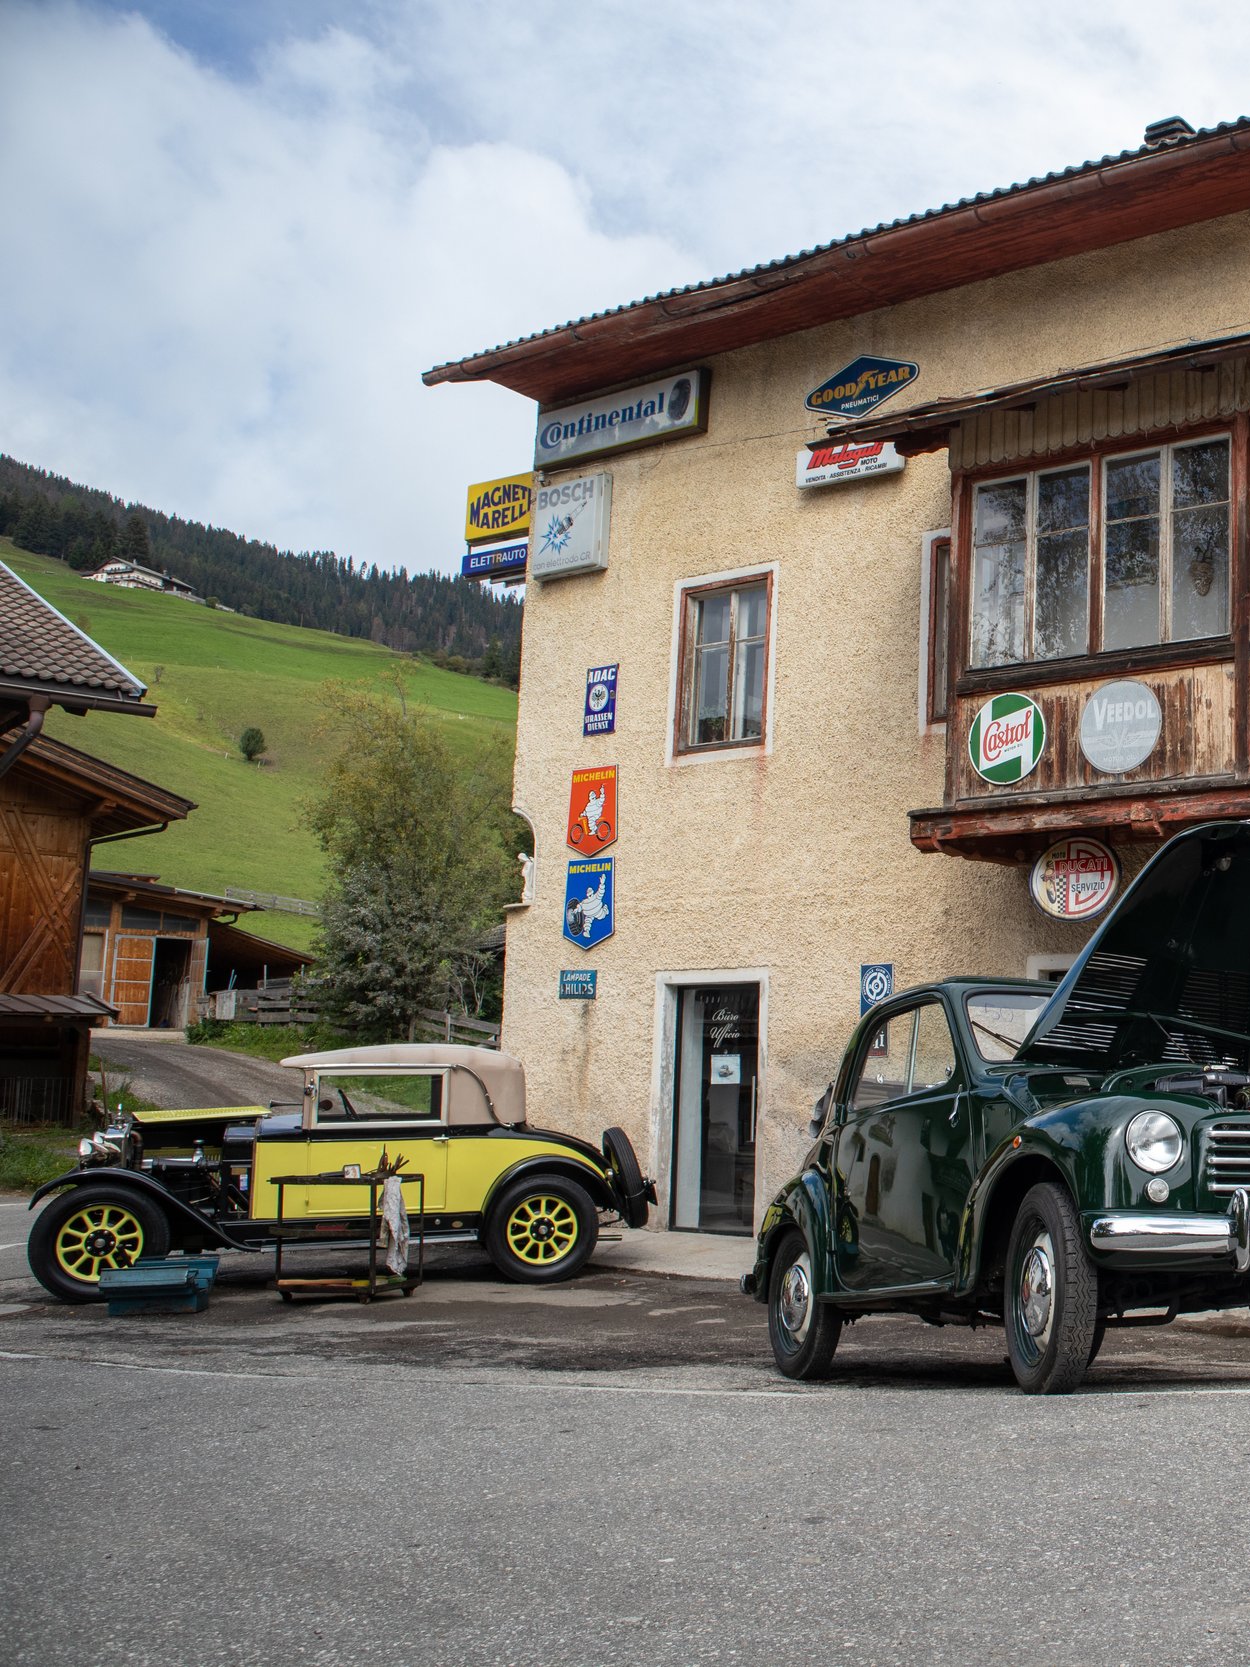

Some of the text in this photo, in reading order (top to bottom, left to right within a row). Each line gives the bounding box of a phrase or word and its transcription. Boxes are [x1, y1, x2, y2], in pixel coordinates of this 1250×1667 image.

[840, 394, 880, 410] PNEUMATICI
[539, 391, 666, 450] Continental
[860, 457, 878, 466] MOTO
[805, 462, 888, 484] VENDITA ASSISTENZA RICAMBI
[537, 479, 595, 511] BOSCH
[470, 548, 527, 569] ELETTRAUTO
[533, 561, 546, 571] con
[587, 667, 616, 684] ADAC
[584, 712, 613, 724] STRASSEN
[1092, 698, 1157, 731] VEEDOL
[586, 721, 609, 732] DIENST
[982, 709, 1032, 762] Castrol
[572, 769, 616, 784] MICHELIN
[568, 862, 612, 874] MICHELIN
[1059, 857, 1108, 874] DUCATI
[1071, 881, 1105, 893] SERVIZIO
[563, 973, 592, 982] LAMPADE
[710, 1023, 741, 1048] Ufficio
